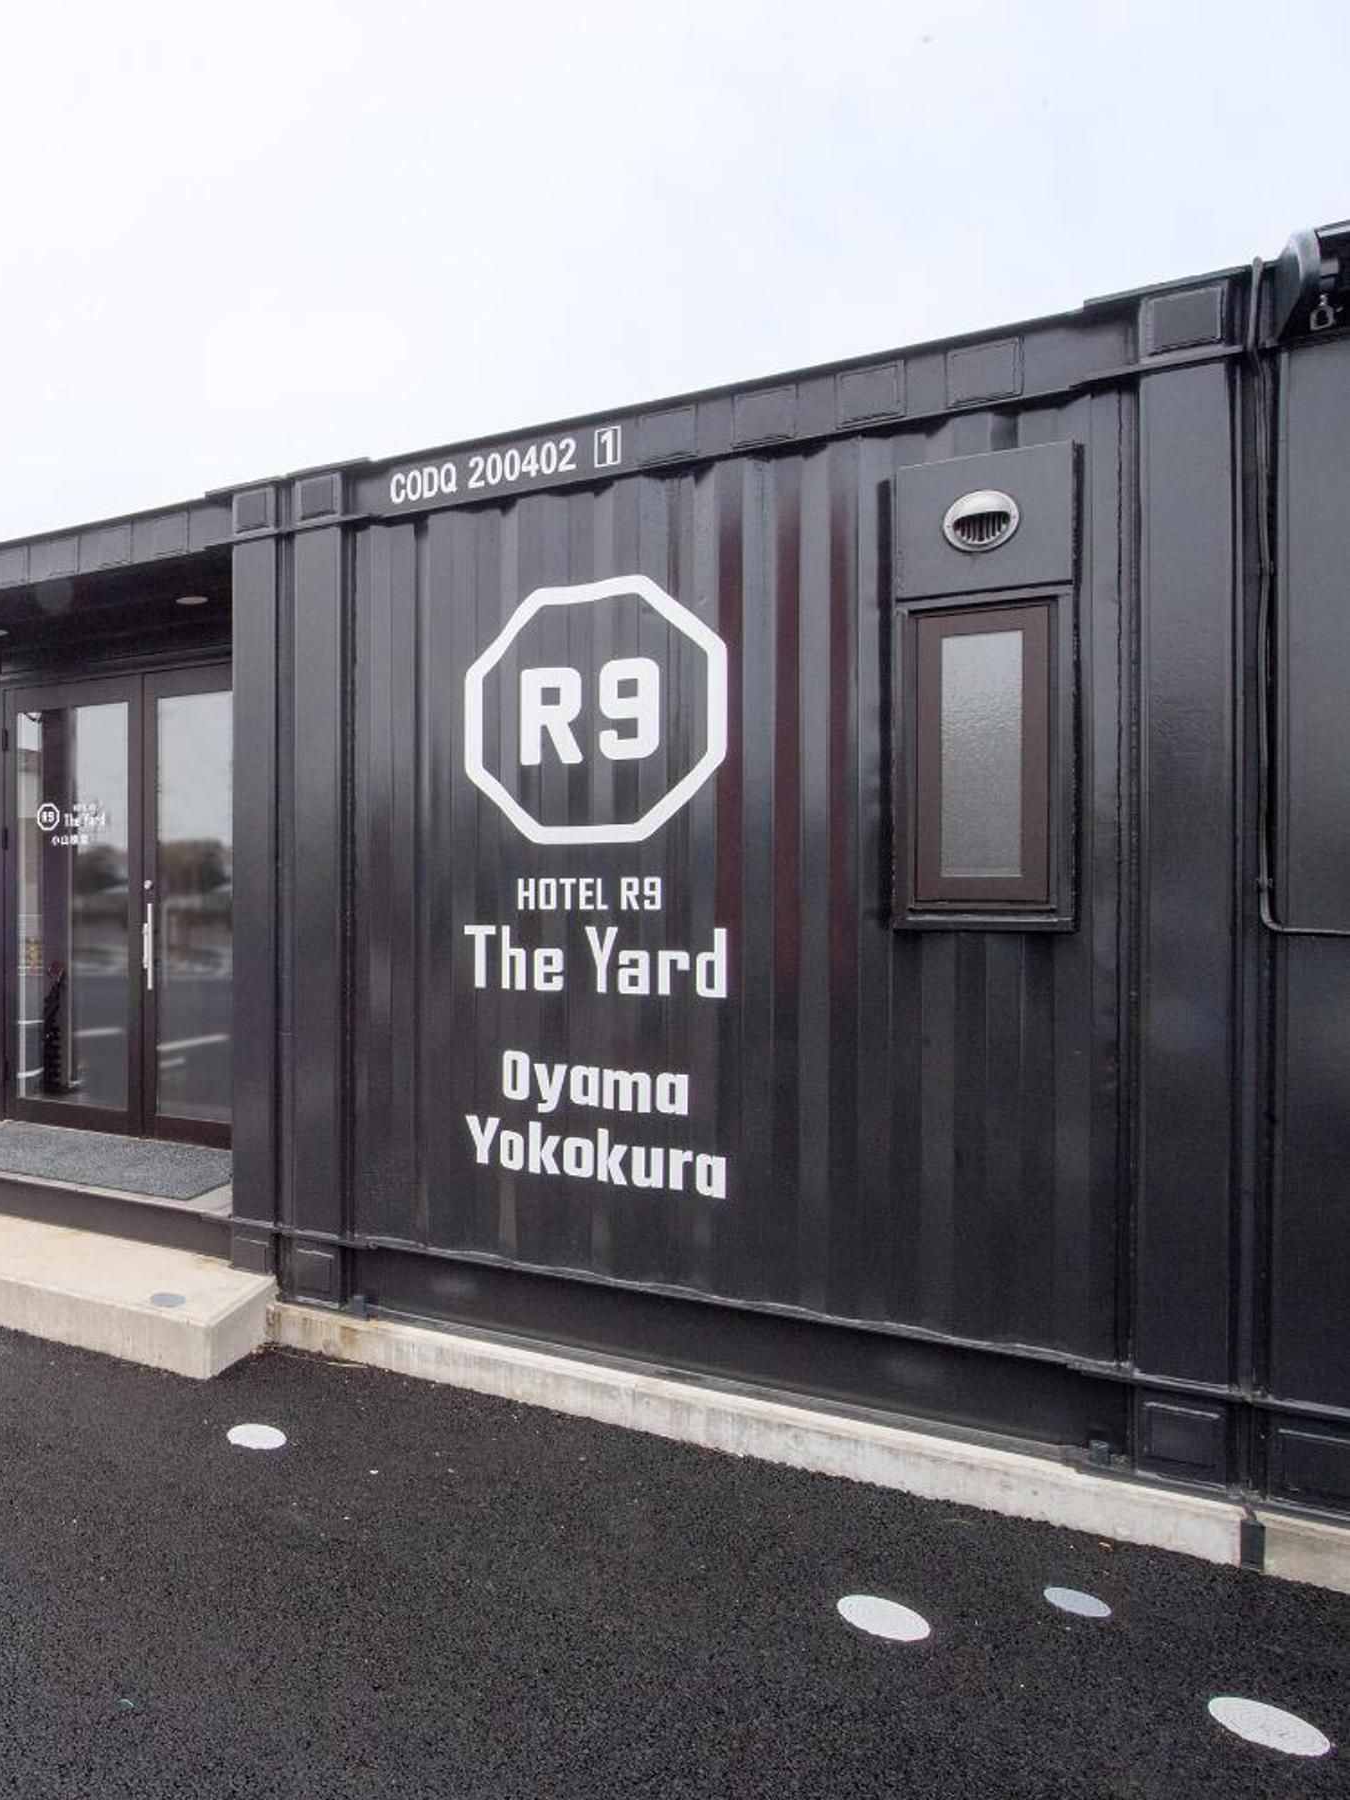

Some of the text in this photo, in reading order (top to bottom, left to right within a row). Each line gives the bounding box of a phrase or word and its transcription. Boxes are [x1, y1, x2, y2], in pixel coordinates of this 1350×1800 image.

[390, 426, 618, 505] CODQ 200402 1
[519, 656, 660, 765] R9
[517, 877, 662, 911] HOTEL R9
[464, 924, 727, 998] The Yard
[502, 1049, 689, 1116] Oyama
[465, 1115, 727, 1200] Yokokura
